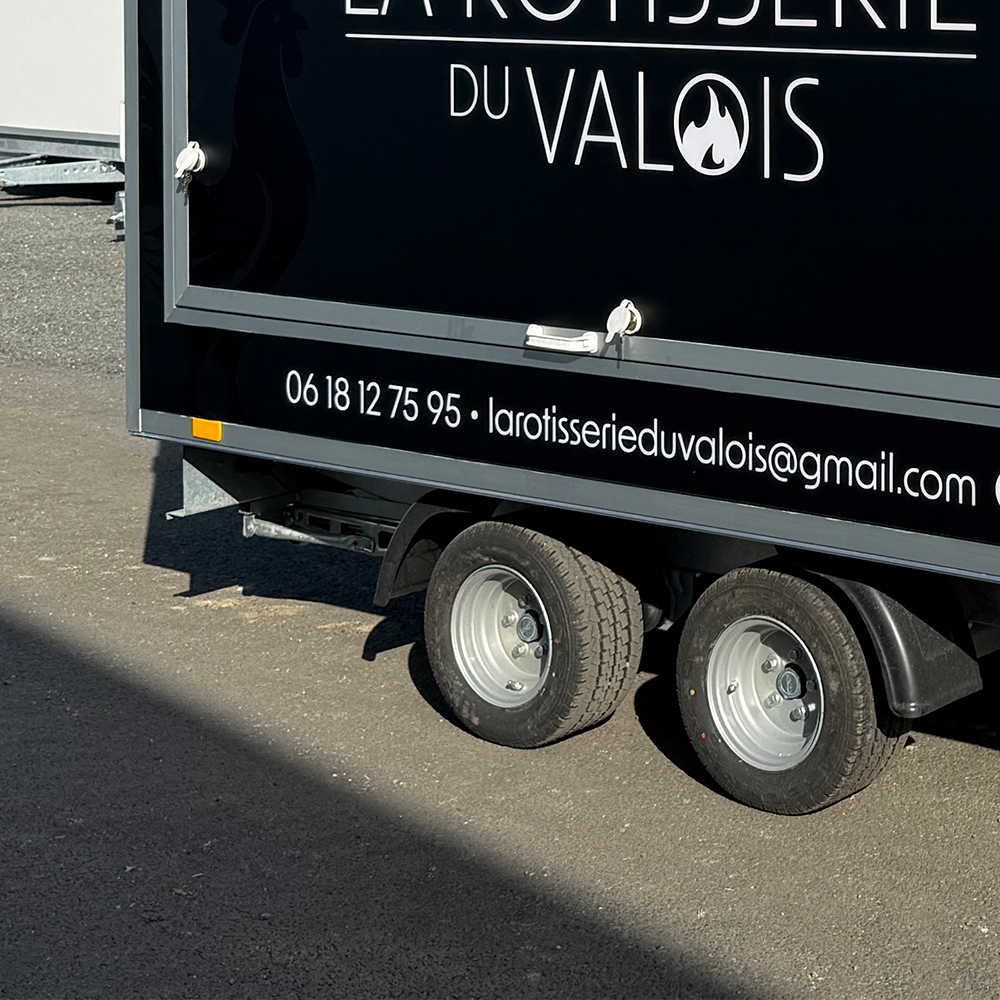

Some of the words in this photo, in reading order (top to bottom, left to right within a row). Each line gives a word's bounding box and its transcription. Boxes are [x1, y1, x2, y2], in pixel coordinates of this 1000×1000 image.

[450, 63, 509, 120] DU
[525, 66, 825, 183] VALOIS
[285, 369, 319, 406] 06
[325, 375, 351, 411] 18
[357, 379, 382, 417] 12
[388, 384, 420, 422] 75
[426, 390, 461, 428] 95
[488, 395, 977, 508] larotisserieduvalois@gmail.com
